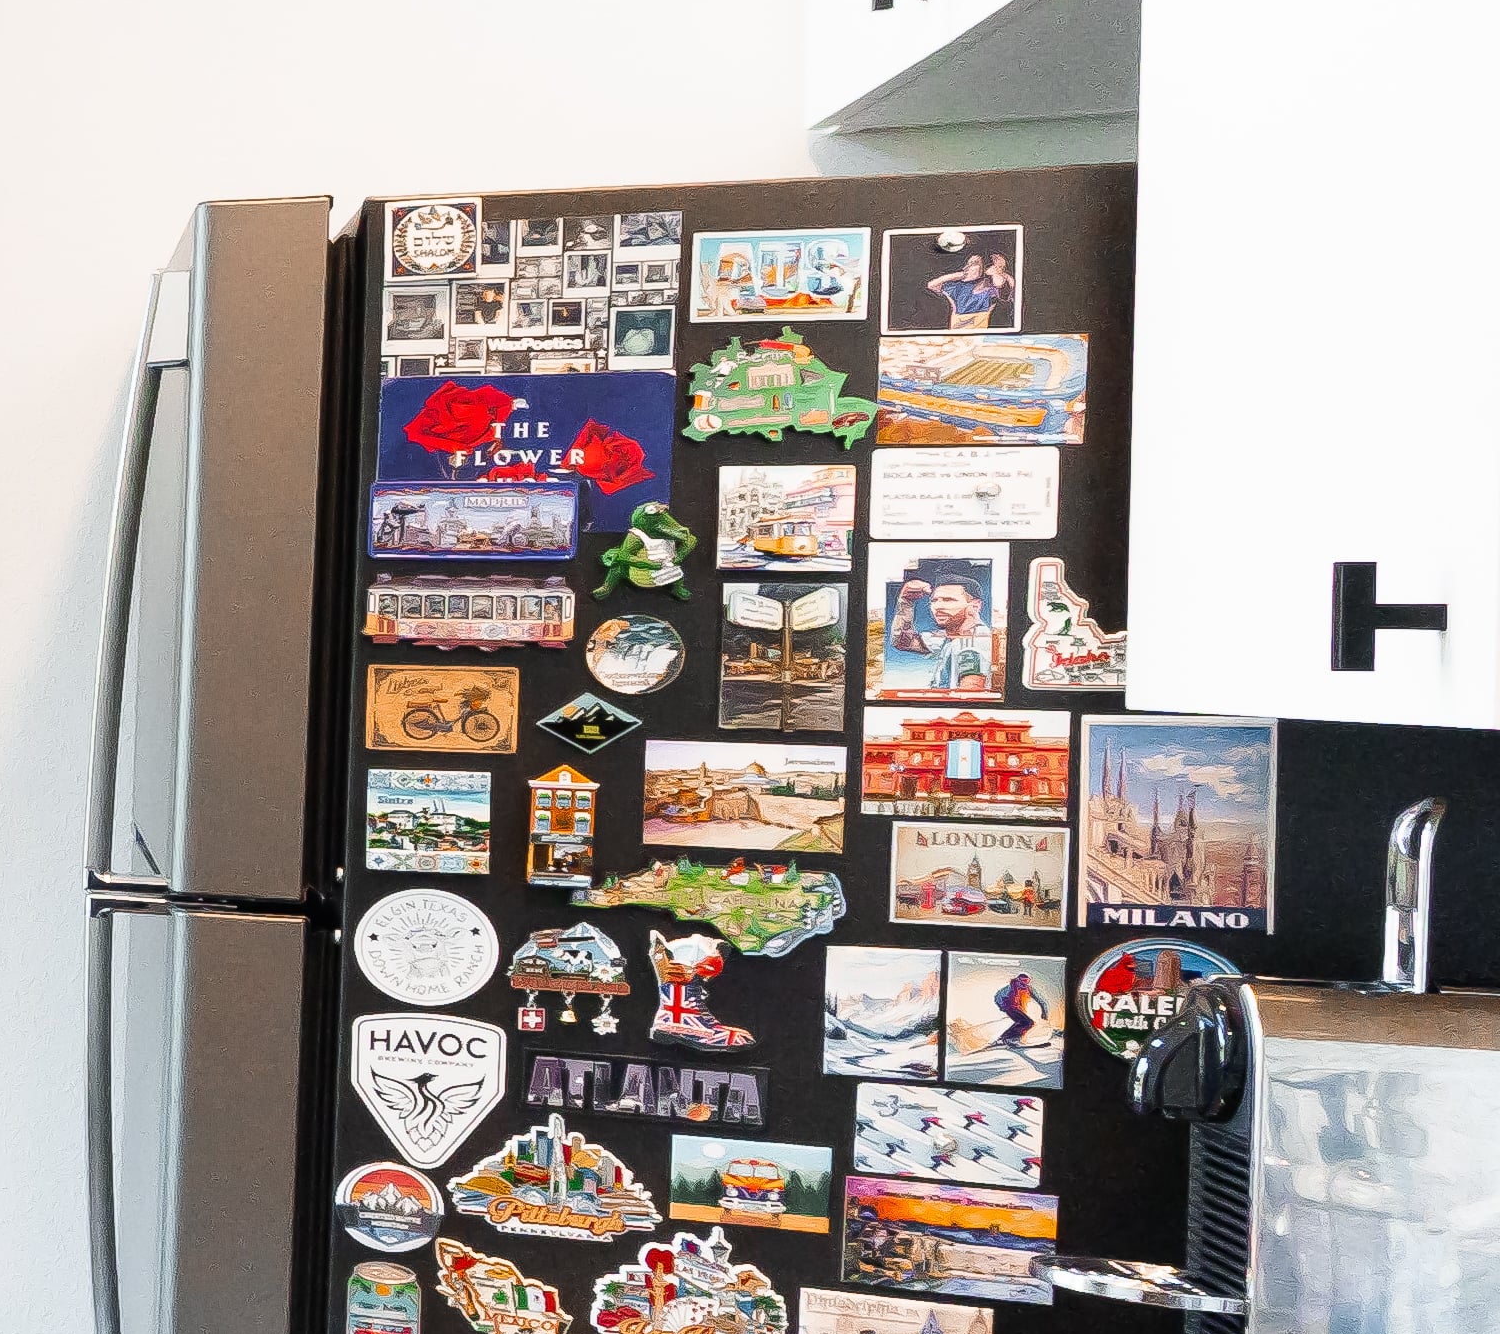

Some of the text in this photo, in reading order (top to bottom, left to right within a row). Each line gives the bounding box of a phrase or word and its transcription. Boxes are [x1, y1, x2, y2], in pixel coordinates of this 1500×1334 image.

[413, 247, 455, 258] SHALOM
[487, 335, 584, 351] WaxPoetics
[491, 421, 550, 439] THE
[454, 449, 586, 466] FLOWER
[466, 497, 529, 508] MADRID
[931, 830, 1034, 850] LONDON
[422, 898, 468, 923] TEXAS
[1102, 907, 1250, 929] MILANO
[368, 944, 485, 996] DOWN HOME RANCH
[1092, 991, 1186, 1015] RALEI
[1103, 1012, 1148, 1030] North
[369, 1029, 488, 1059] HAVOC
[377, 1055, 475, 1068] BREWING COMPANY
[526, 1056, 764, 1125] ATLANTA
[488, 1197, 626, 1236] Pittsburgh
